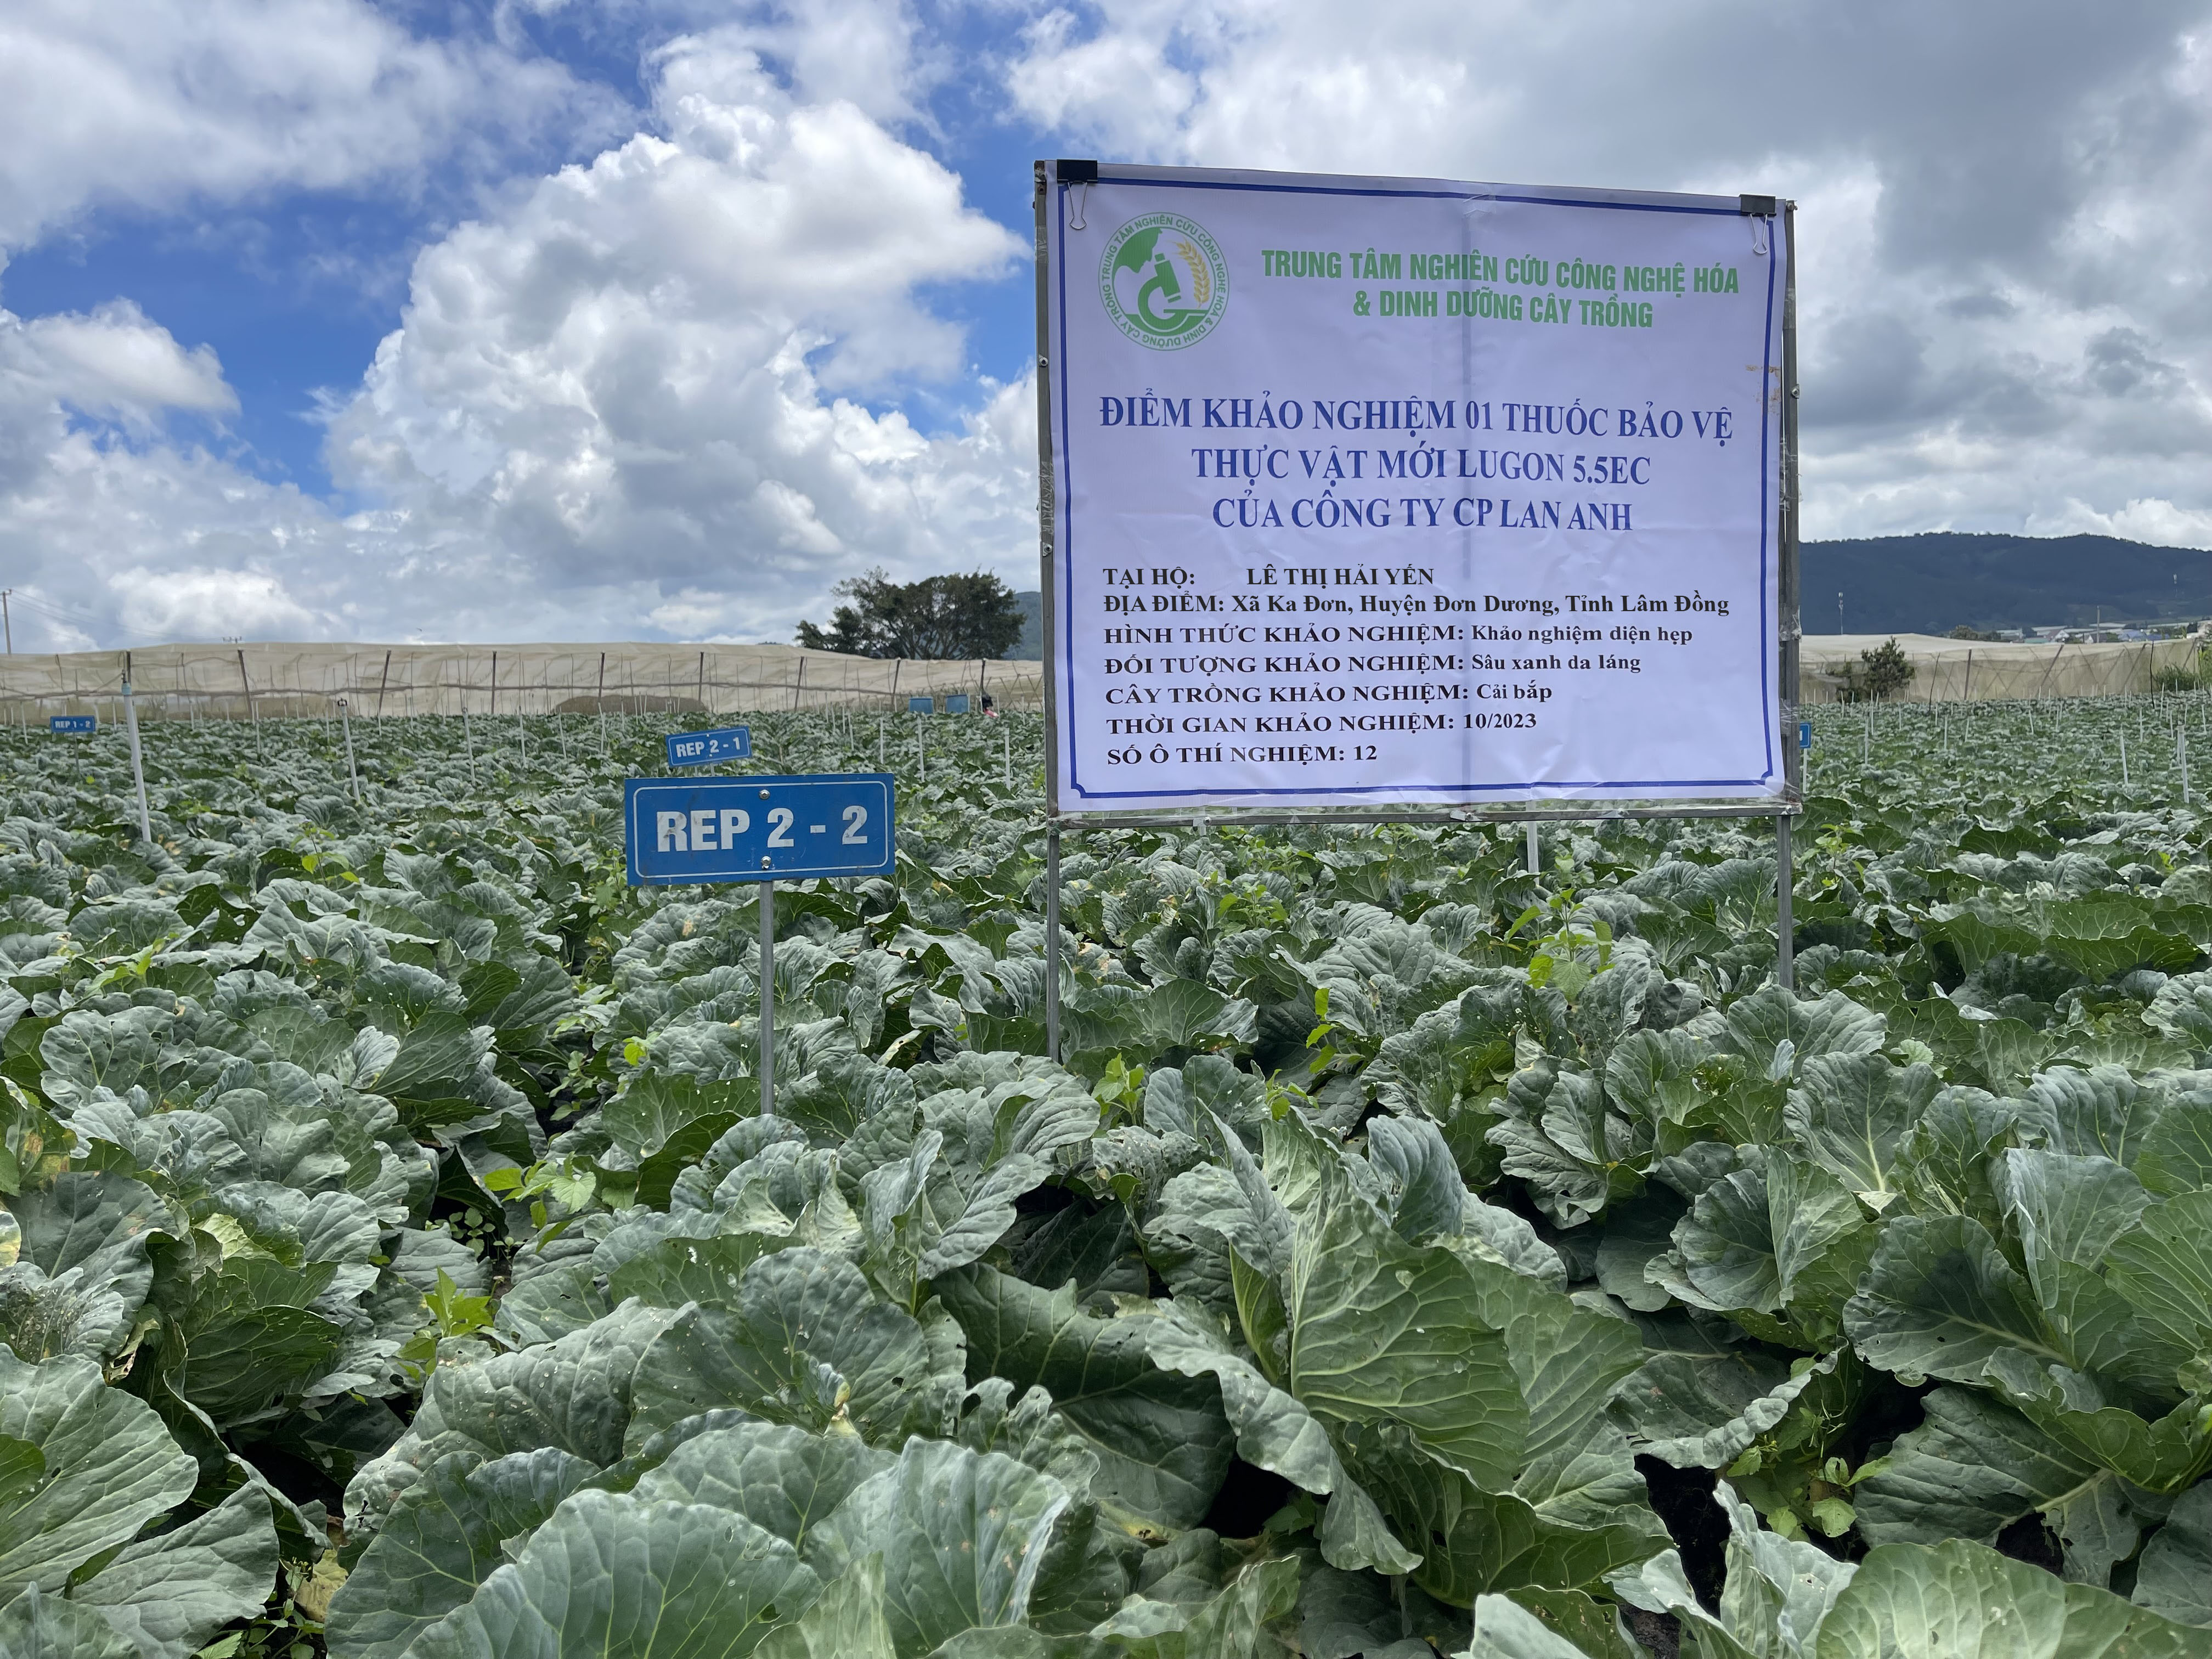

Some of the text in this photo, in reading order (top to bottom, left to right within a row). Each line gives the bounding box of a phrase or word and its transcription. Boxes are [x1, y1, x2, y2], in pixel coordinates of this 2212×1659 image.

[1114, 225, 1135, 245] TÂM
[1135, 215, 1173, 230] NGHIÊN
[1176, 219, 1198, 235] CỨU
[1198, 233, 1220, 261] CÔNG
[1102, 245, 1117, 281] TRUNG
[1261, 247, 1739, 298] TRUNG TÂM NGHIÊN CỨU CÔNG NGHỆ HÓA
[1215, 263, 1226, 294] NGHỆ
[1353, 286, 1653, 328] & DINH DƯỠNG CÂY TRỒNG
[1120, 321, 1140, 338] CÂY
[1183, 324, 1206, 343] DINH
[1204, 317, 1213, 325] &
[1099, 387, 1733, 447] ĐIỂM KHẢO NGHIỆM 01 THUỐC BẢO VỆ
[1191, 440, 1650, 488] THỰC VẬT MỚI LUGON 5.5EC
[1212, 489, 1633, 531] CỦA CÔNG TY CP LAN ANH
[1102, 563, 1435, 589] TẠI HỘ: LÊ THỊ HẢI YẾN
[1103, 590, 1729, 617] ĐỊA ĐIỂM: Xã Ka Đơn, Huyện Đơn Dương, Tỉnh Lâm Đồng
[1103, 622, 1692, 646] HÌNH THỨC KHẢO NGHIỆM: Khảo nghiệm diện hẹp
[1104, 652, 1641, 677] ĐỐI TƯỢNG KHẢO NGHIỆM: Sâu xanh da láng
[1105, 679, 1552, 704] CÂY TRỒNG KHẢO NGHIỆM: Cải bắp
[1106, 712, 1537, 735] THỜI GIAN KHẢO NGHIỆM: 10/2023
[675, 741, 705, 758] REP
[709, 740, 719, 753] 2
[732, 737, 740, 750] 1
[1107, 742, 1378, 766] SỐ Ô THÍ NGHIỆM: 12
[656, 805, 868, 853] REP 2 - 2
